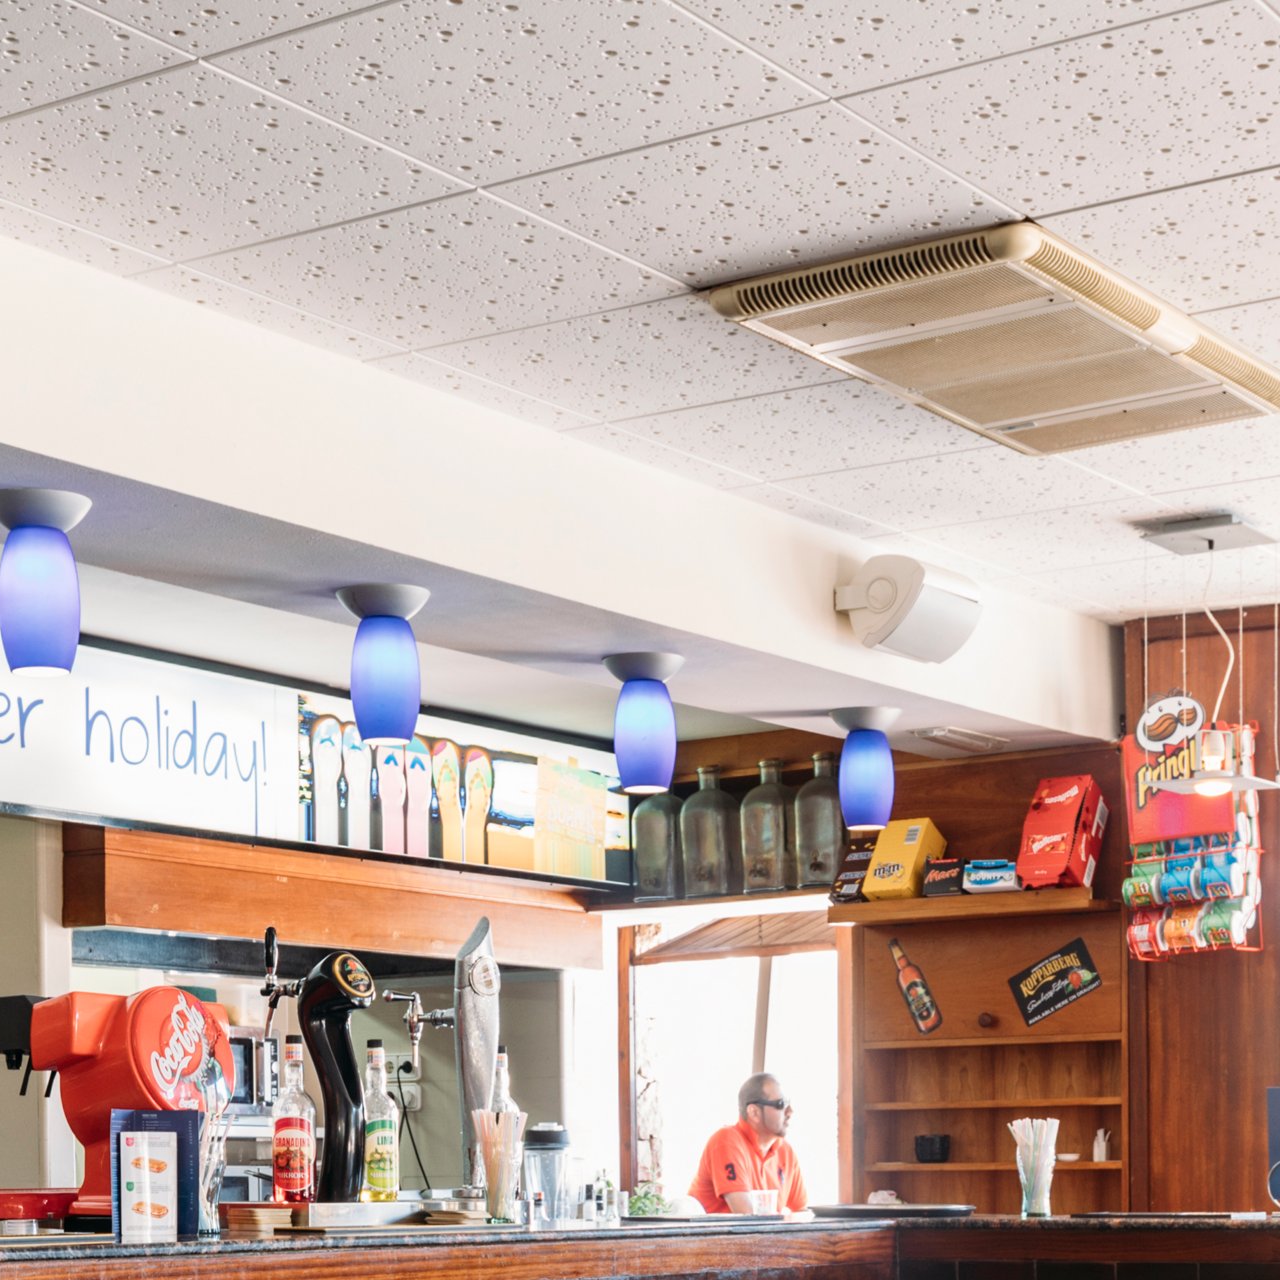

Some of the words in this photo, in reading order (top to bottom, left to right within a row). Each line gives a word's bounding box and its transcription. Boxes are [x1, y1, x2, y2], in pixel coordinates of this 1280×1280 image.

[84, 686, 268, 836] holiday!
[1136, 738, 1201, 809] Pringl
[1020, 953, 1081, 997] KOPPARBERG
[725, 1163, 737, 1181] 3
